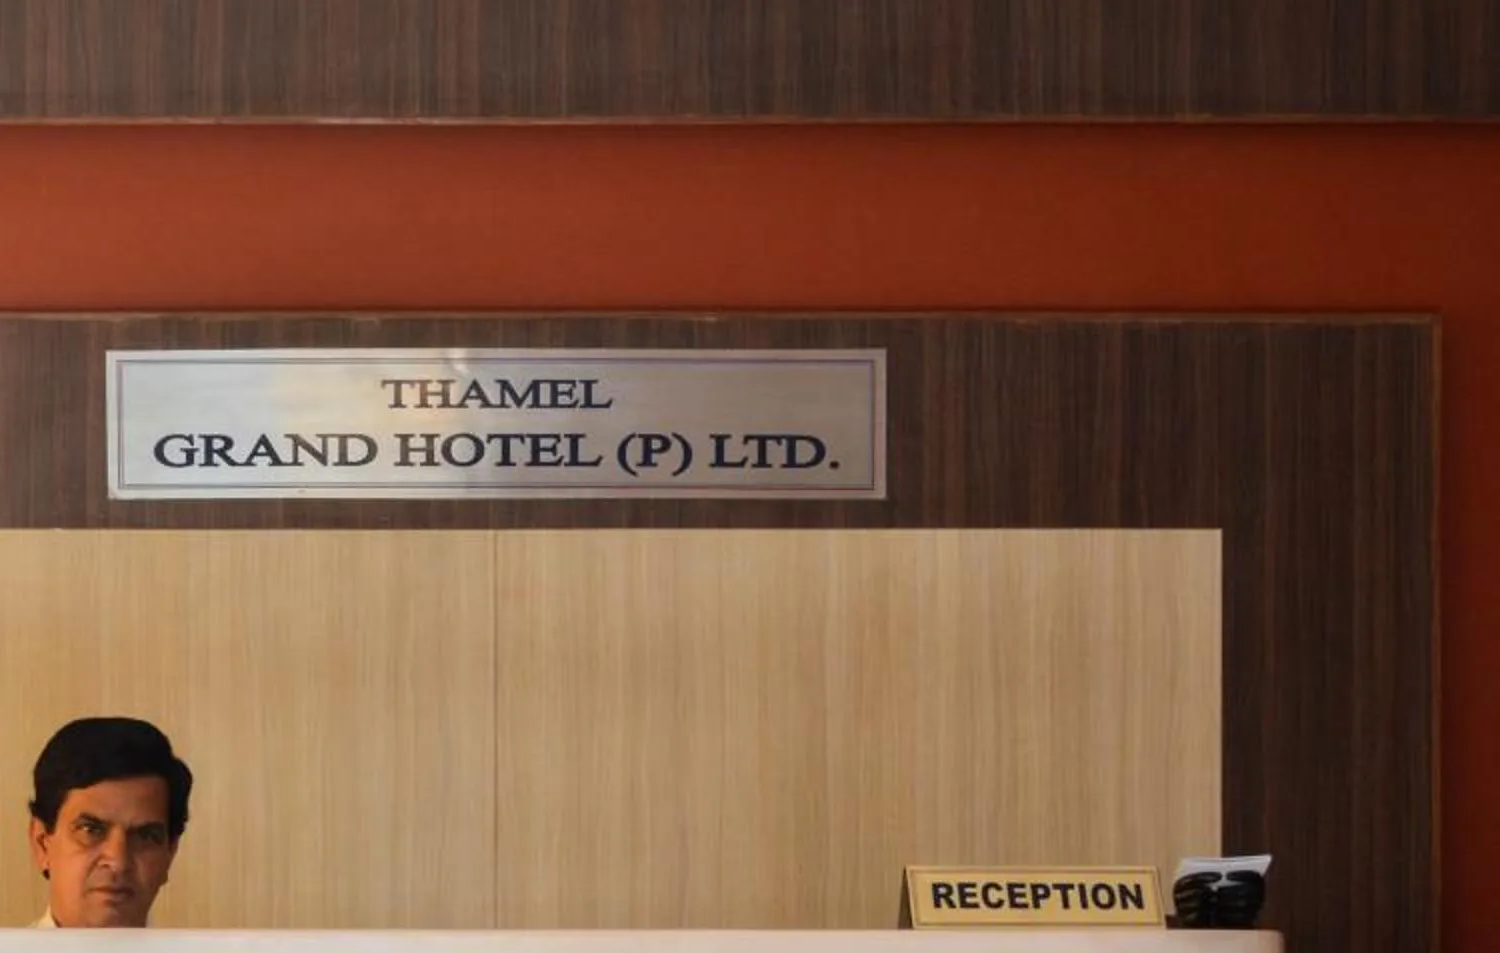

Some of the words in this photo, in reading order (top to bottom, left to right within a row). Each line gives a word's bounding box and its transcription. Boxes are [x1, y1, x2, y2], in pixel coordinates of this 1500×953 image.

[381, 378, 613, 410] THAMEL
[153, 433, 378, 468] GRAND
[394, 433, 603, 468] HOTEL
[617, 432, 693, 476] (P)
[709, 433, 841, 470] LTD.
[931, 881, 1145, 910] RECEPTION
